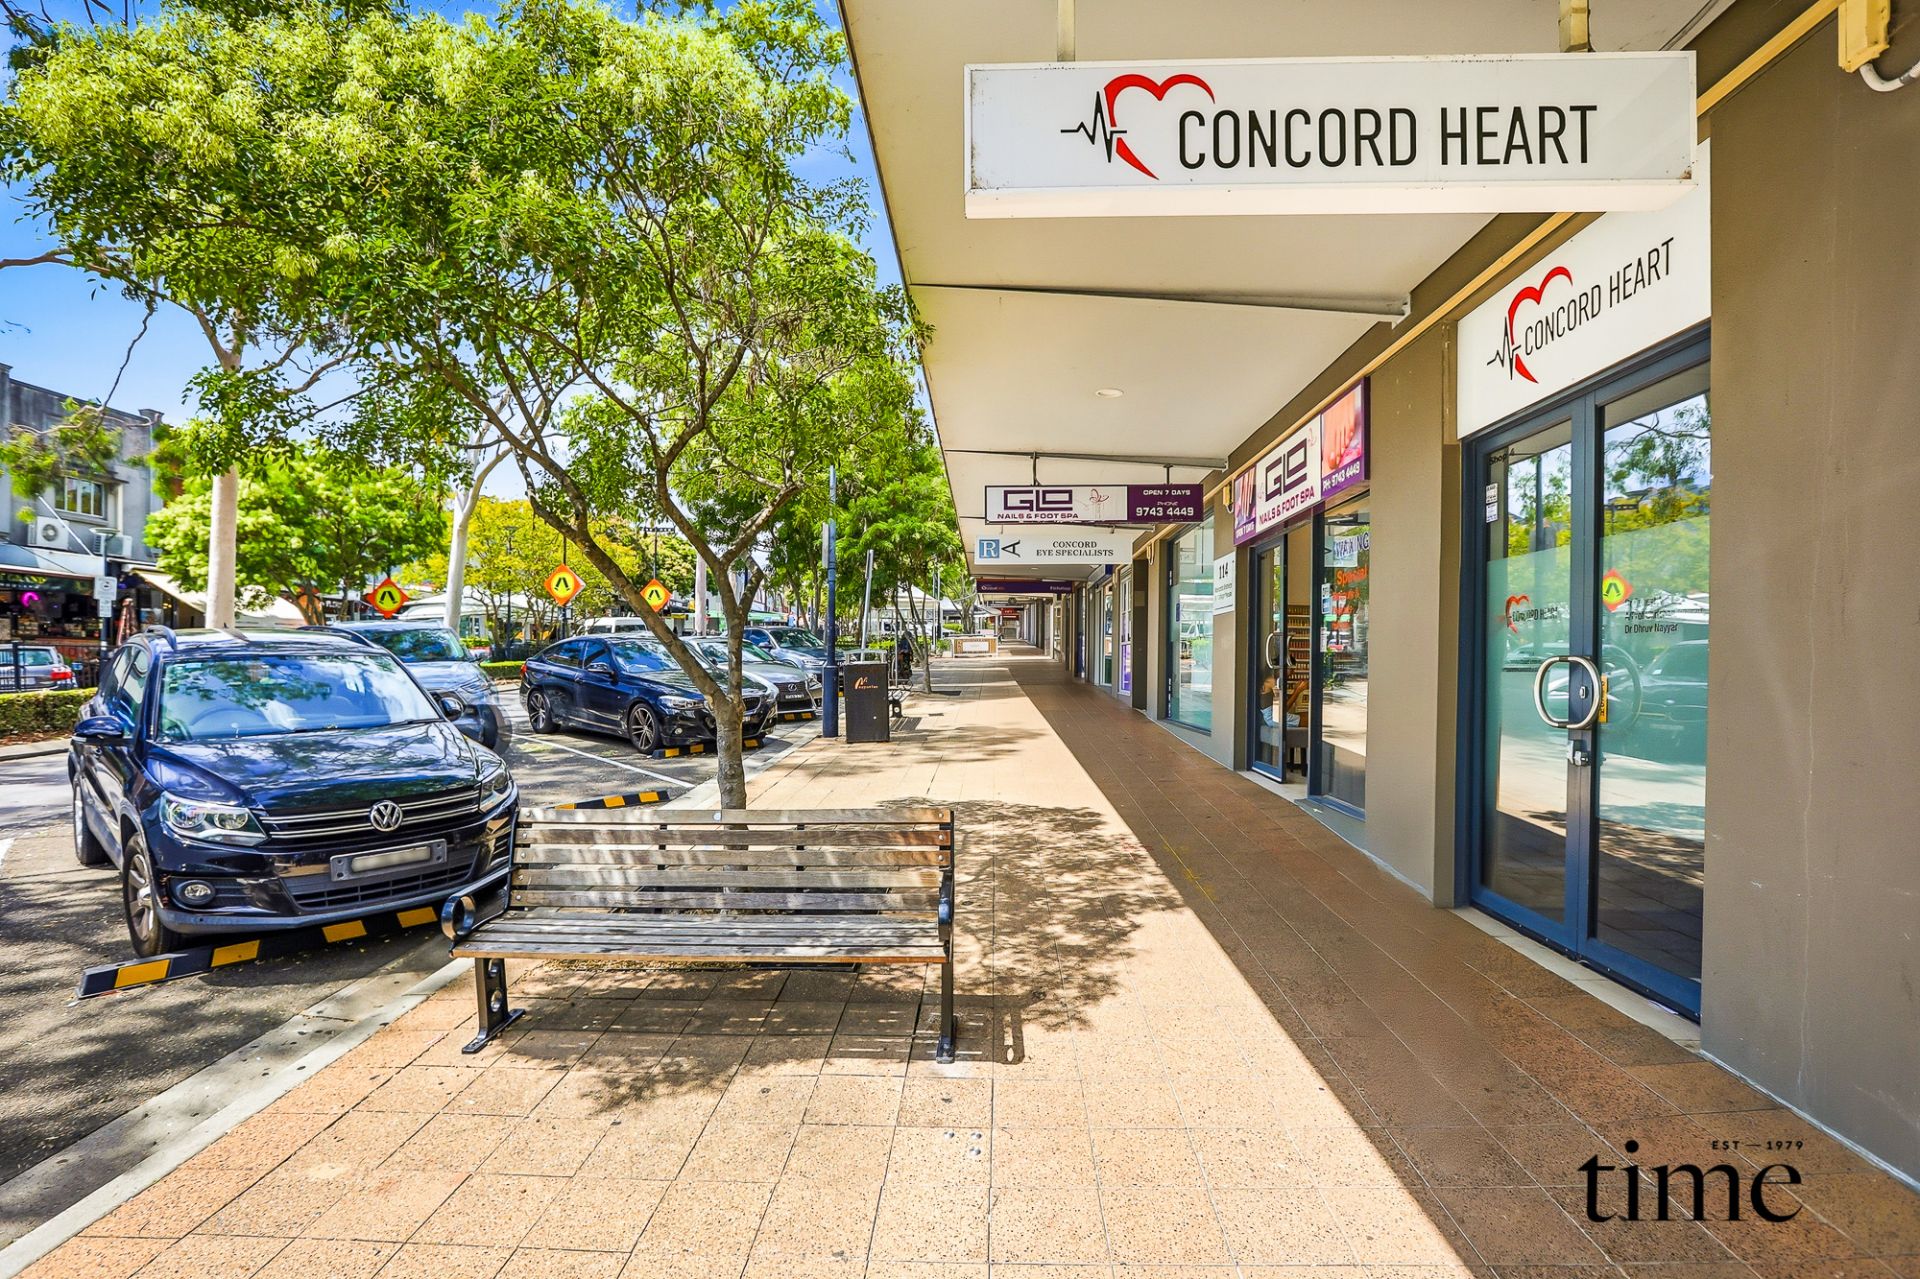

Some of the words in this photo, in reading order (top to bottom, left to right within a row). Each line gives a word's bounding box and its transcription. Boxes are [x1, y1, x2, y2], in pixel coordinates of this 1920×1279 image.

[1178, 106, 1417, 169] CONCORD
[1440, 104, 1598, 166] HEART
[1524, 283, 1602, 357] CONCORD
[1608, 236, 1675, 309] HEART
[1260, 507, 1276, 525] NAILS
[1281, 493, 1299, 514] FOOT
[1300, 485, 1315, 504] SPA
[1136, 507, 1163, 517] 9743
[1166, 507, 1194, 517] 4449
[1052, 540, 1098, 549] CONCORD
[1036, 549, 1053, 557] EYE
[1055, 549, 1114, 557] SPECIALISTS
[1625, 625, 1632, 634] Dr
